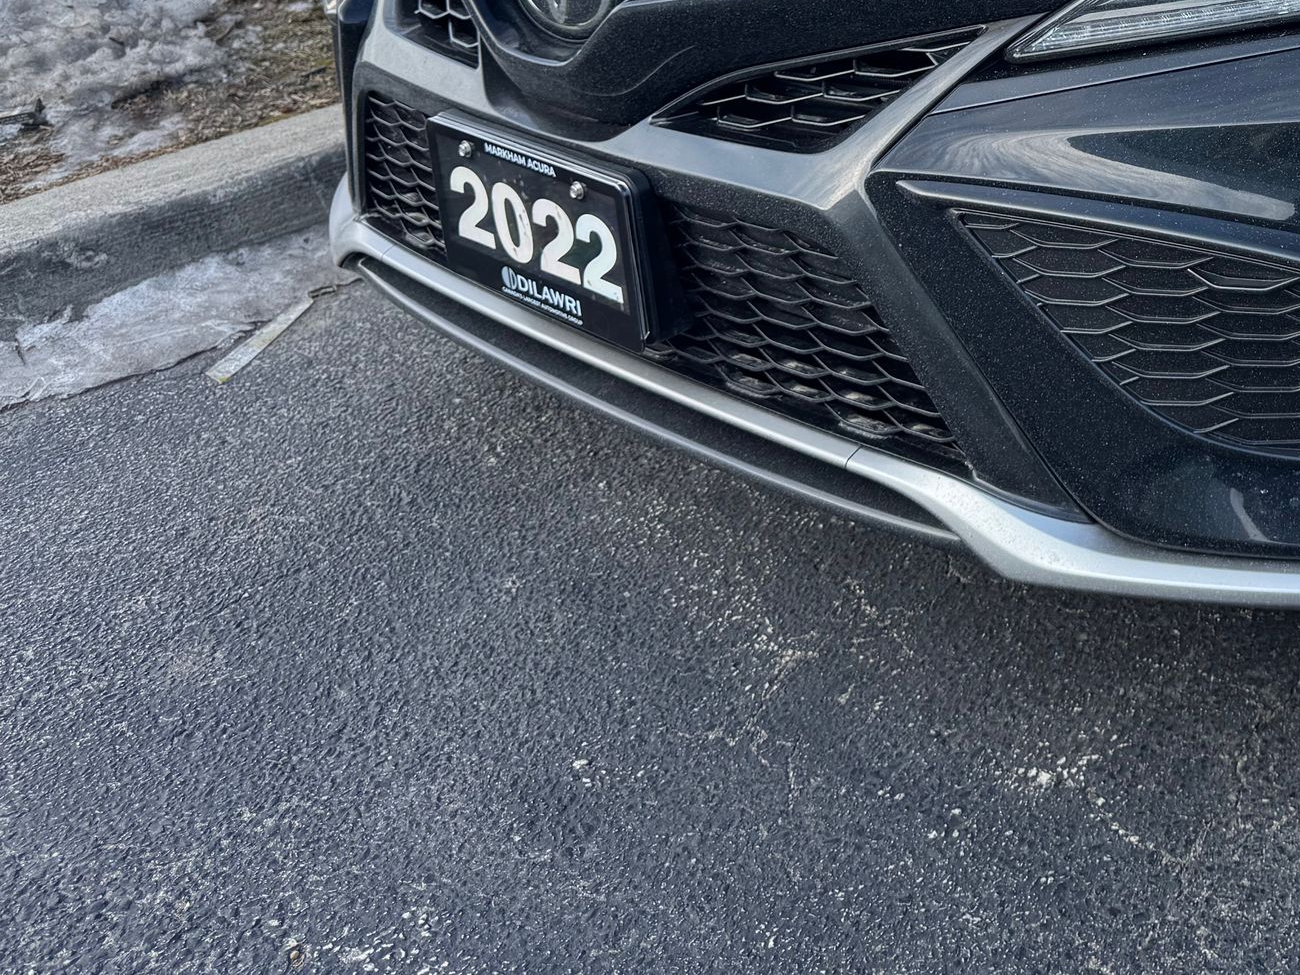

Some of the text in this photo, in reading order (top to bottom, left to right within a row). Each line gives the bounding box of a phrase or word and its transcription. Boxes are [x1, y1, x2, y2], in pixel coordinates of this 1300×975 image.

[484, 142, 557, 178] MARKHAM ACURA
[450, 166, 624, 304] 2022
[516, 274, 582, 317] DILAWRI
